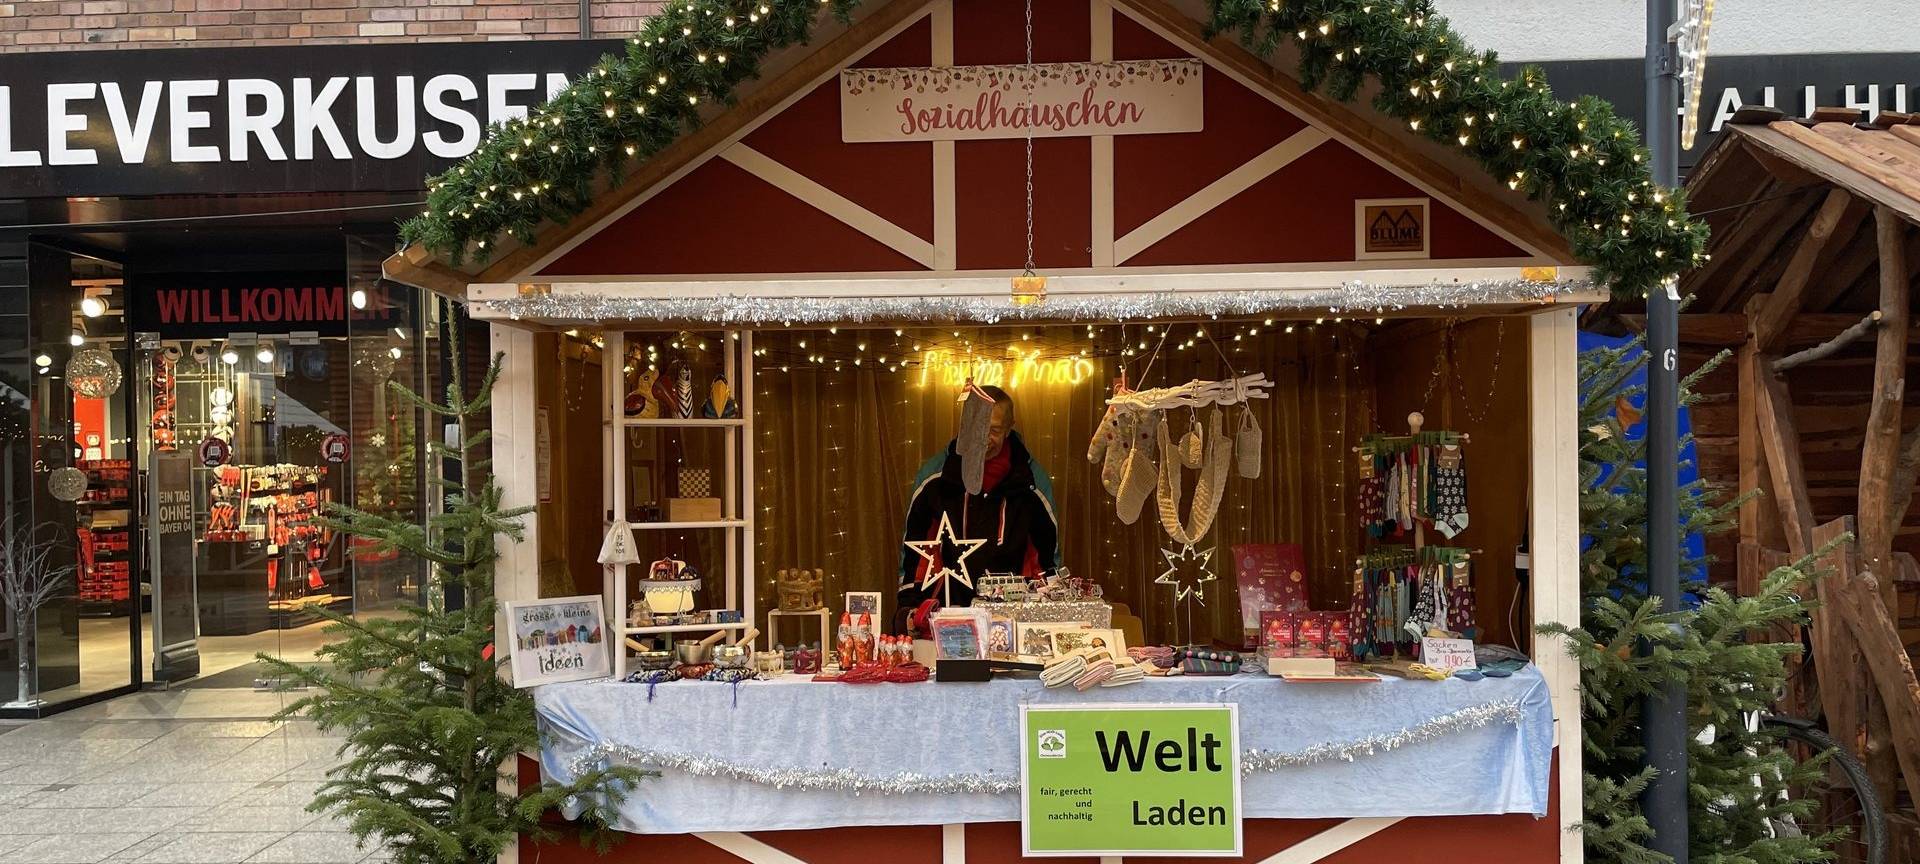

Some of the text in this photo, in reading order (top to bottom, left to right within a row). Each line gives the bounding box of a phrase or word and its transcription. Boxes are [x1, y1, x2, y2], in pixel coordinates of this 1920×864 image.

[897, 87, 1144, 135] Sozialhäuschen
[1664, 348, 1676, 371] 6
[160, 490, 190, 503] EIN TAG
[160, 505, 191, 521] OHNE
[160, 522, 182, 534] BAYER
[563, 608, 592, 618] kleine
[1427, 639, 1458, 648] Socken
[539, 652, 584, 674] Ideen
[1095, 727, 1222, 773] Welt
[1040, 787, 1092, 797] fair, gerecht
[1075, 800, 1092, 808] und
[1048, 812, 1093, 822] nachhaltig
[1132, 799, 1226, 826] Laden
